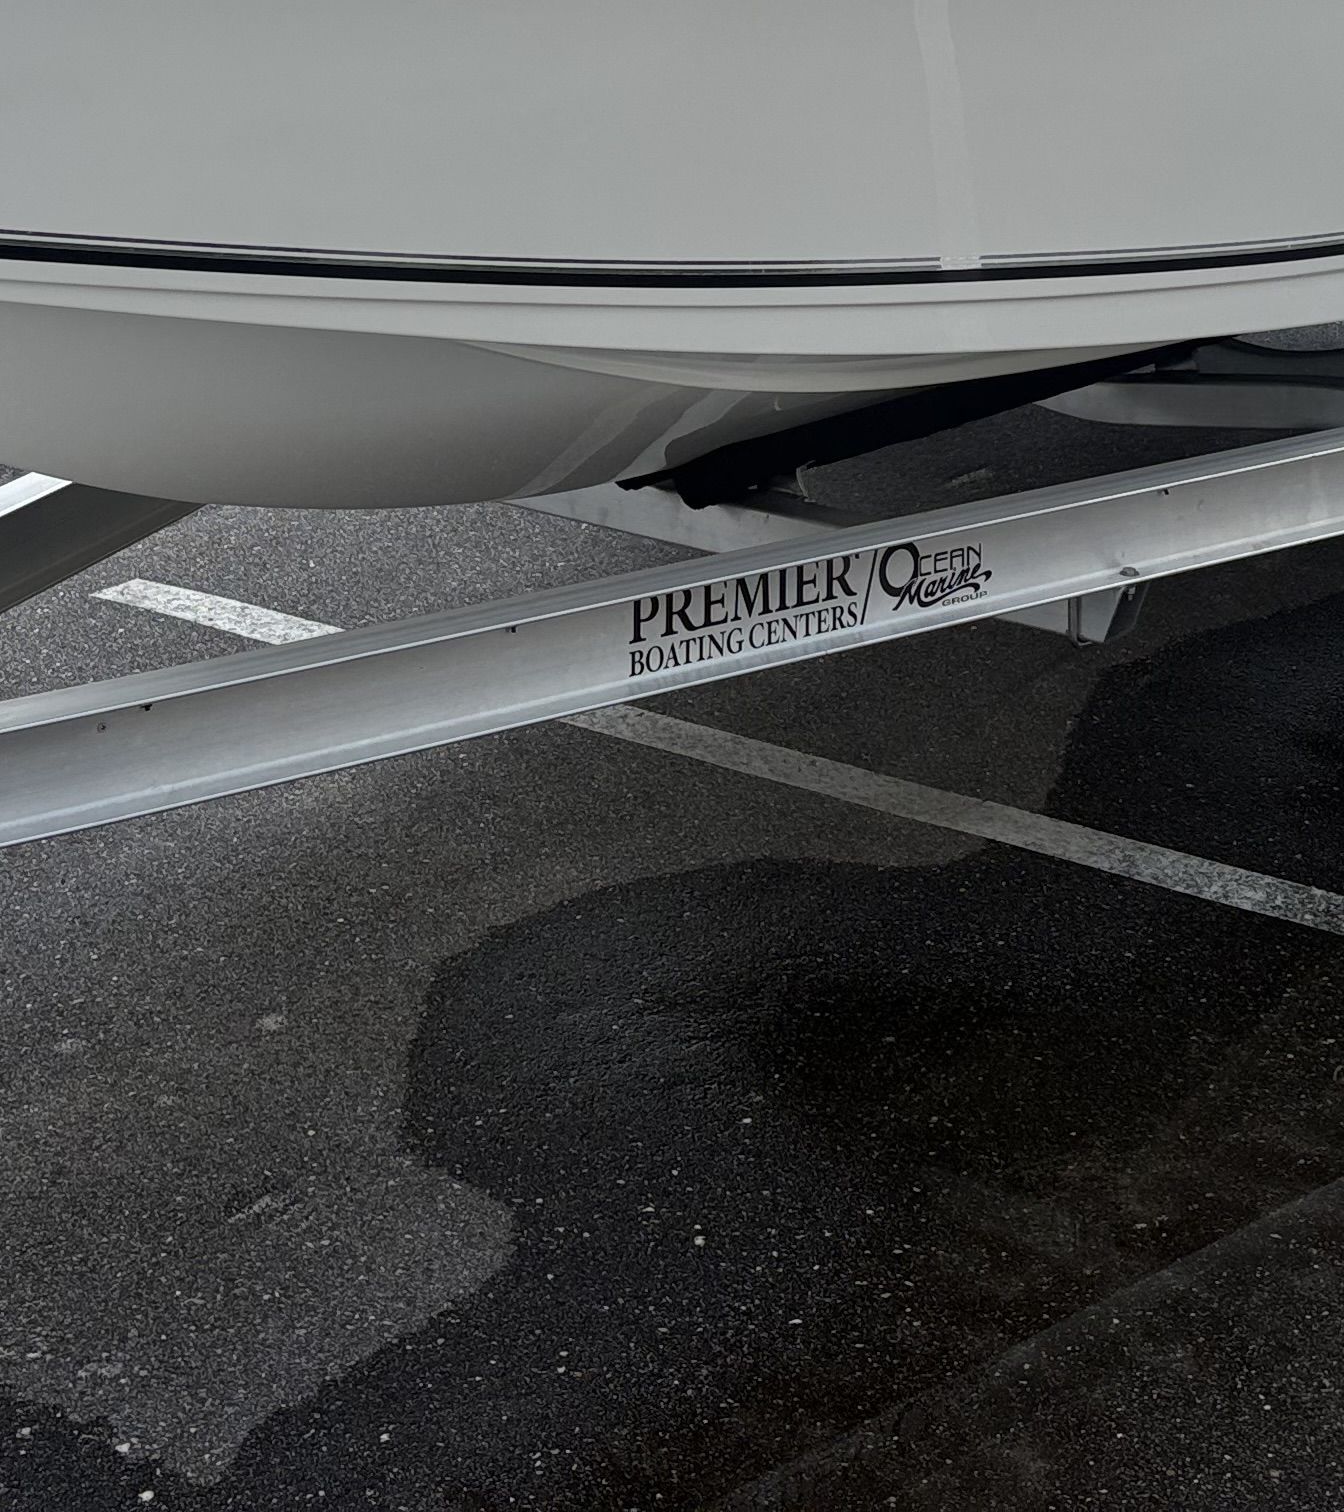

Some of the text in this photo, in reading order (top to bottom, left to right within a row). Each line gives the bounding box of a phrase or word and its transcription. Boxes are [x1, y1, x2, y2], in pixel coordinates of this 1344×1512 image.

[879, 542, 982, 598] OCEAN
[892, 563, 993, 611] Marine
[629, 554, 858, 645] PREMIER
[941, 590, 988, 607] GROUP
[629, 601, 858, 678] BOATING CENTERS
